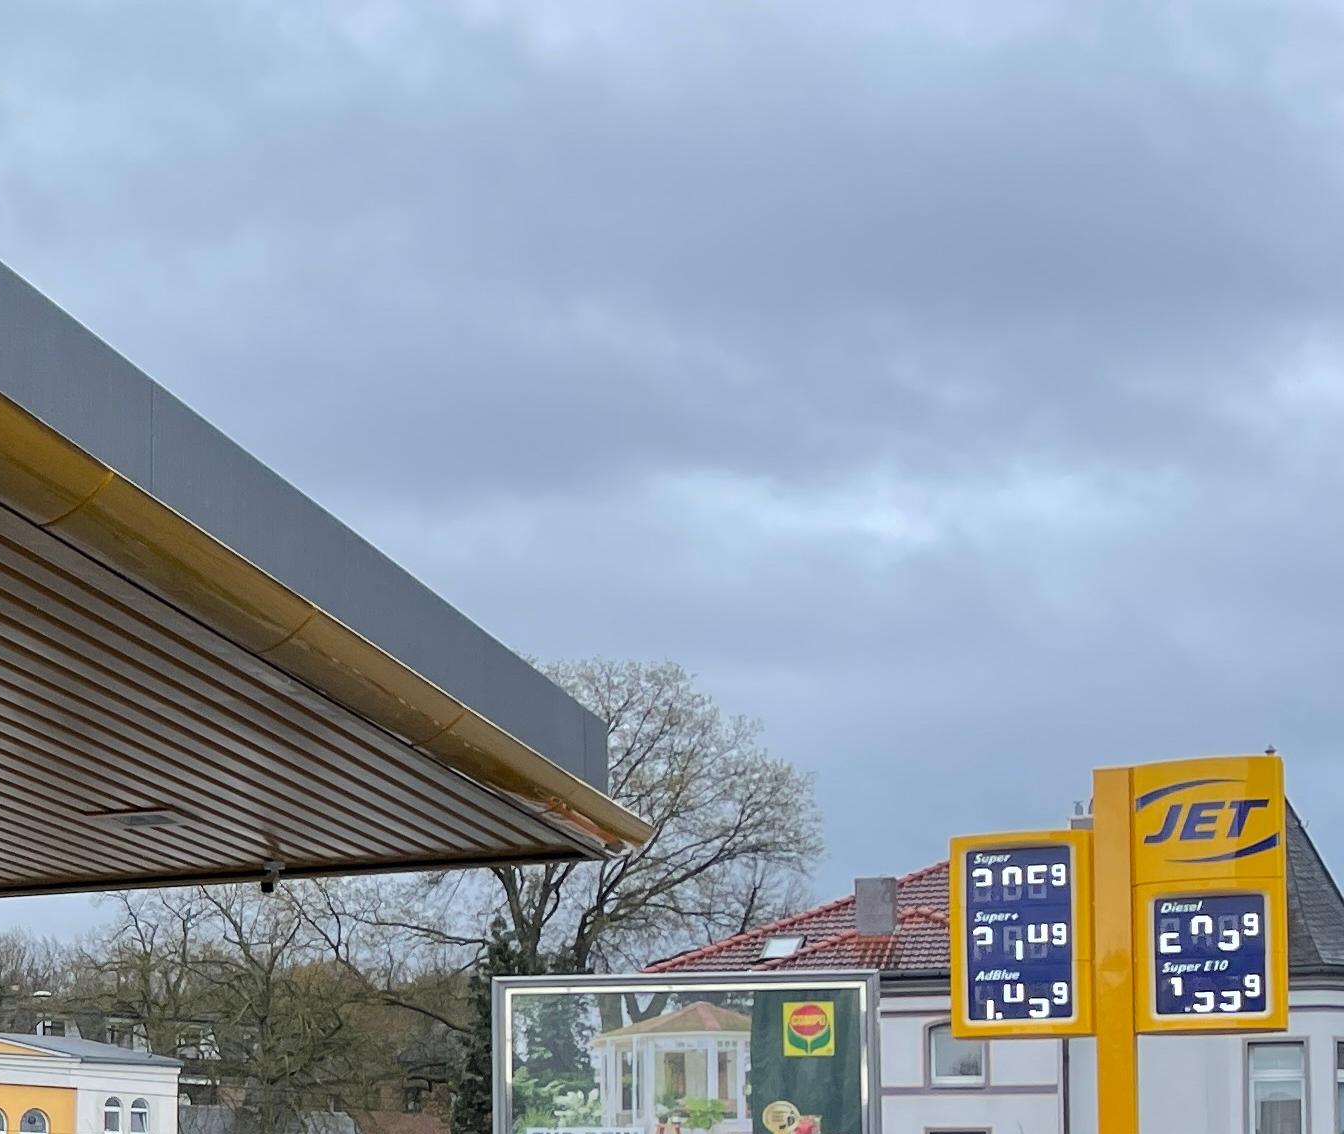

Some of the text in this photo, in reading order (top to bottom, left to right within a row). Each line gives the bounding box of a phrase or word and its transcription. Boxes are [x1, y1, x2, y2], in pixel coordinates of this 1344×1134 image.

[1144, 799, 1269, 844] JET
[974, 853, 1011, 865] Super
[1161, 901, 1203, 913] Diesel
[1162, 961, 1201, 974] Super
[975, 970, 1020, 982] AdBlue
